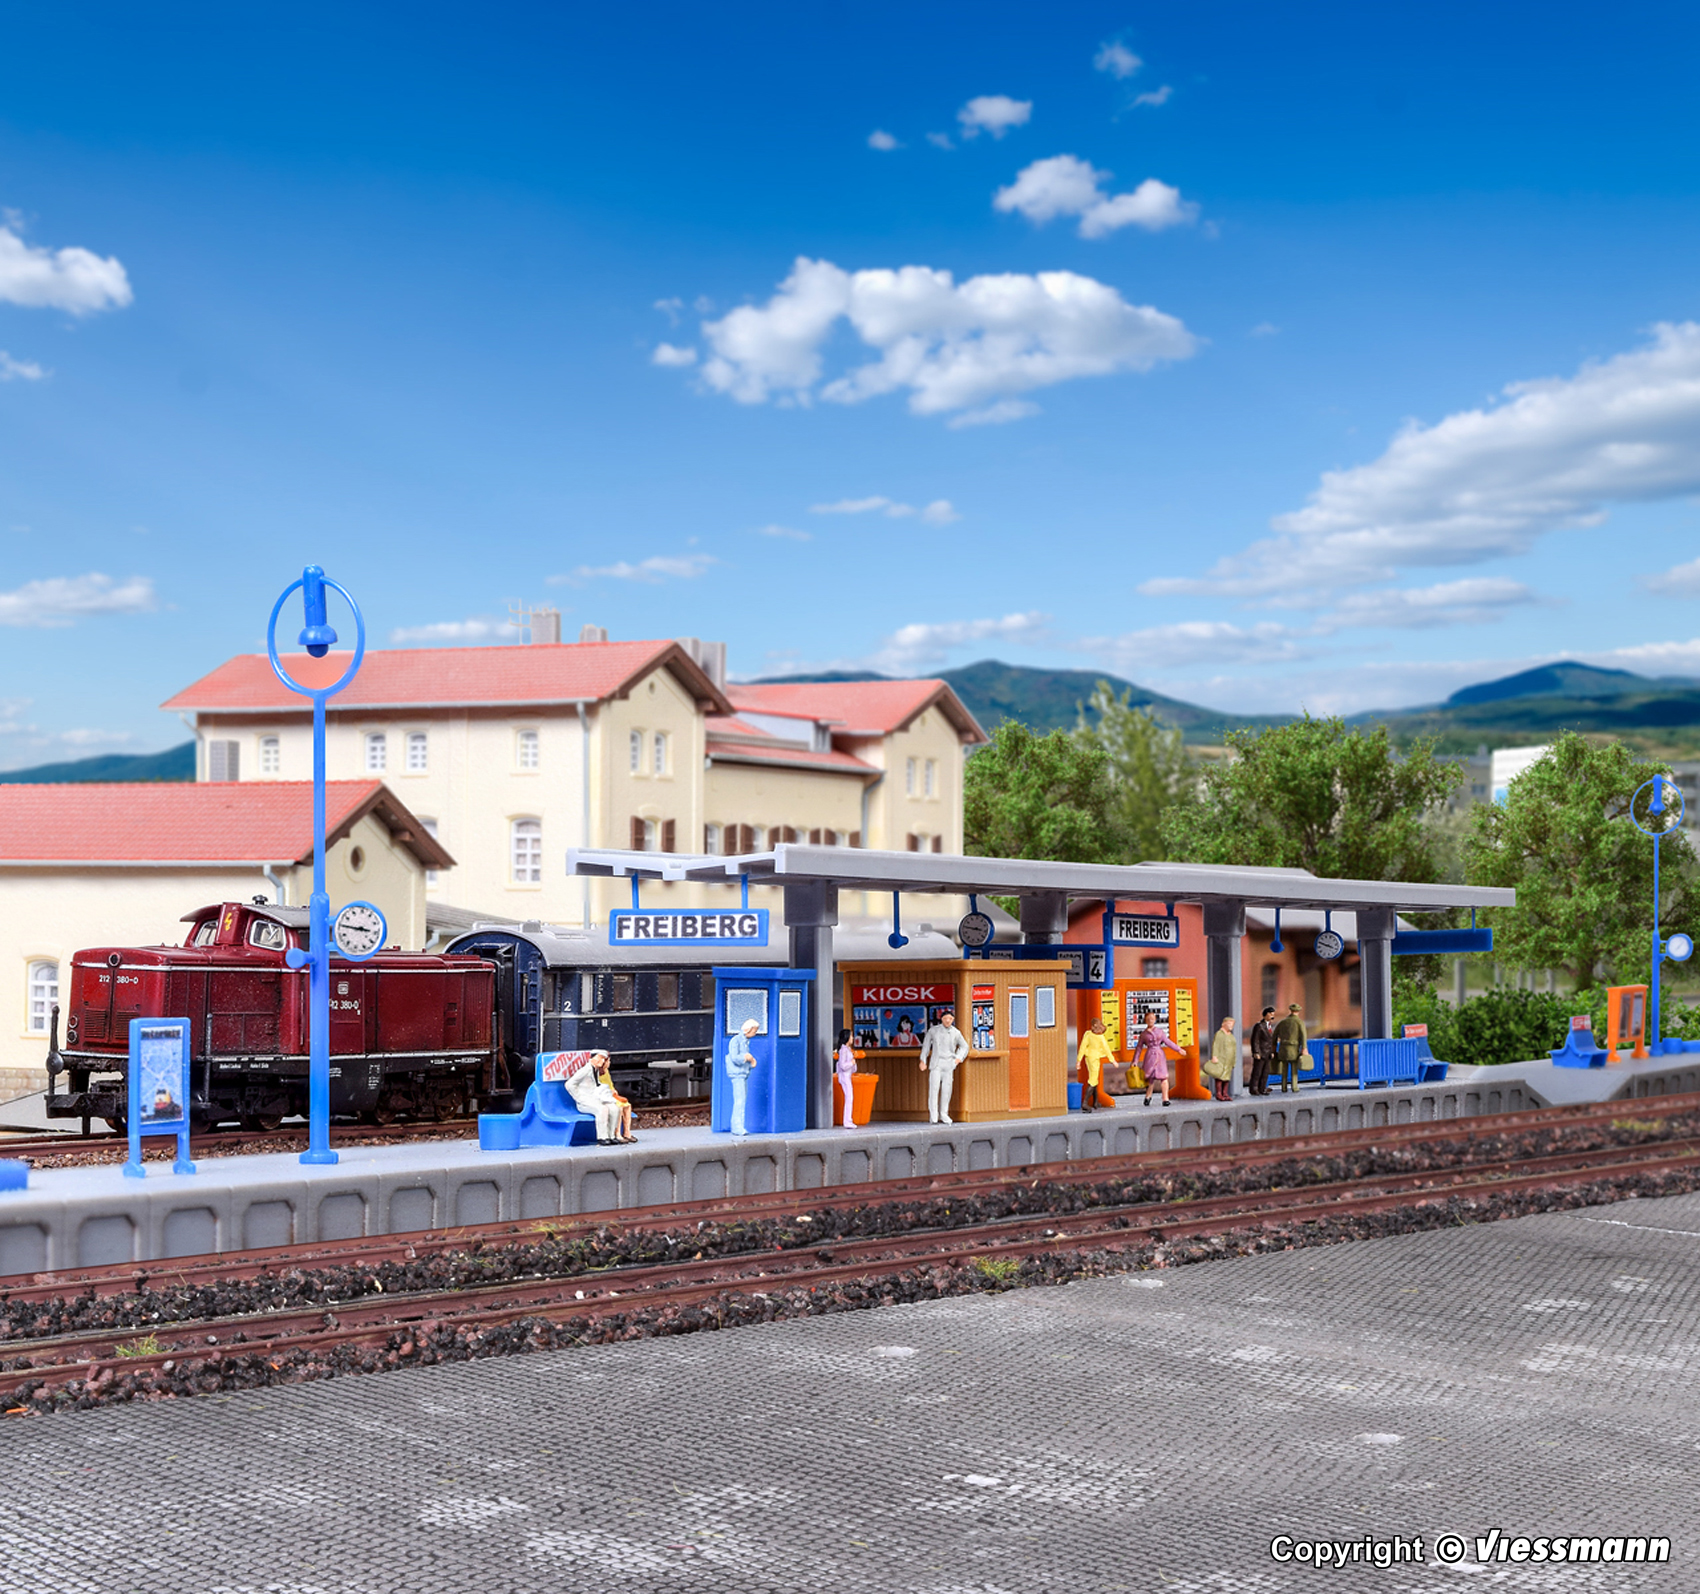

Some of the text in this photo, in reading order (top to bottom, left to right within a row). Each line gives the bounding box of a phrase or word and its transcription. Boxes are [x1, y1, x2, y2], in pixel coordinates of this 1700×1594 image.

[616, 915, 758, 938] FREIBERG
[1119, 919, 1170, 940] FREIBERG
[98, 974, 111, 983] 212
[1090, 961, 1102, 980] 4
[862, 986, 936, 1001] KIOSK
[563, 1000, 572, 1012] 2
